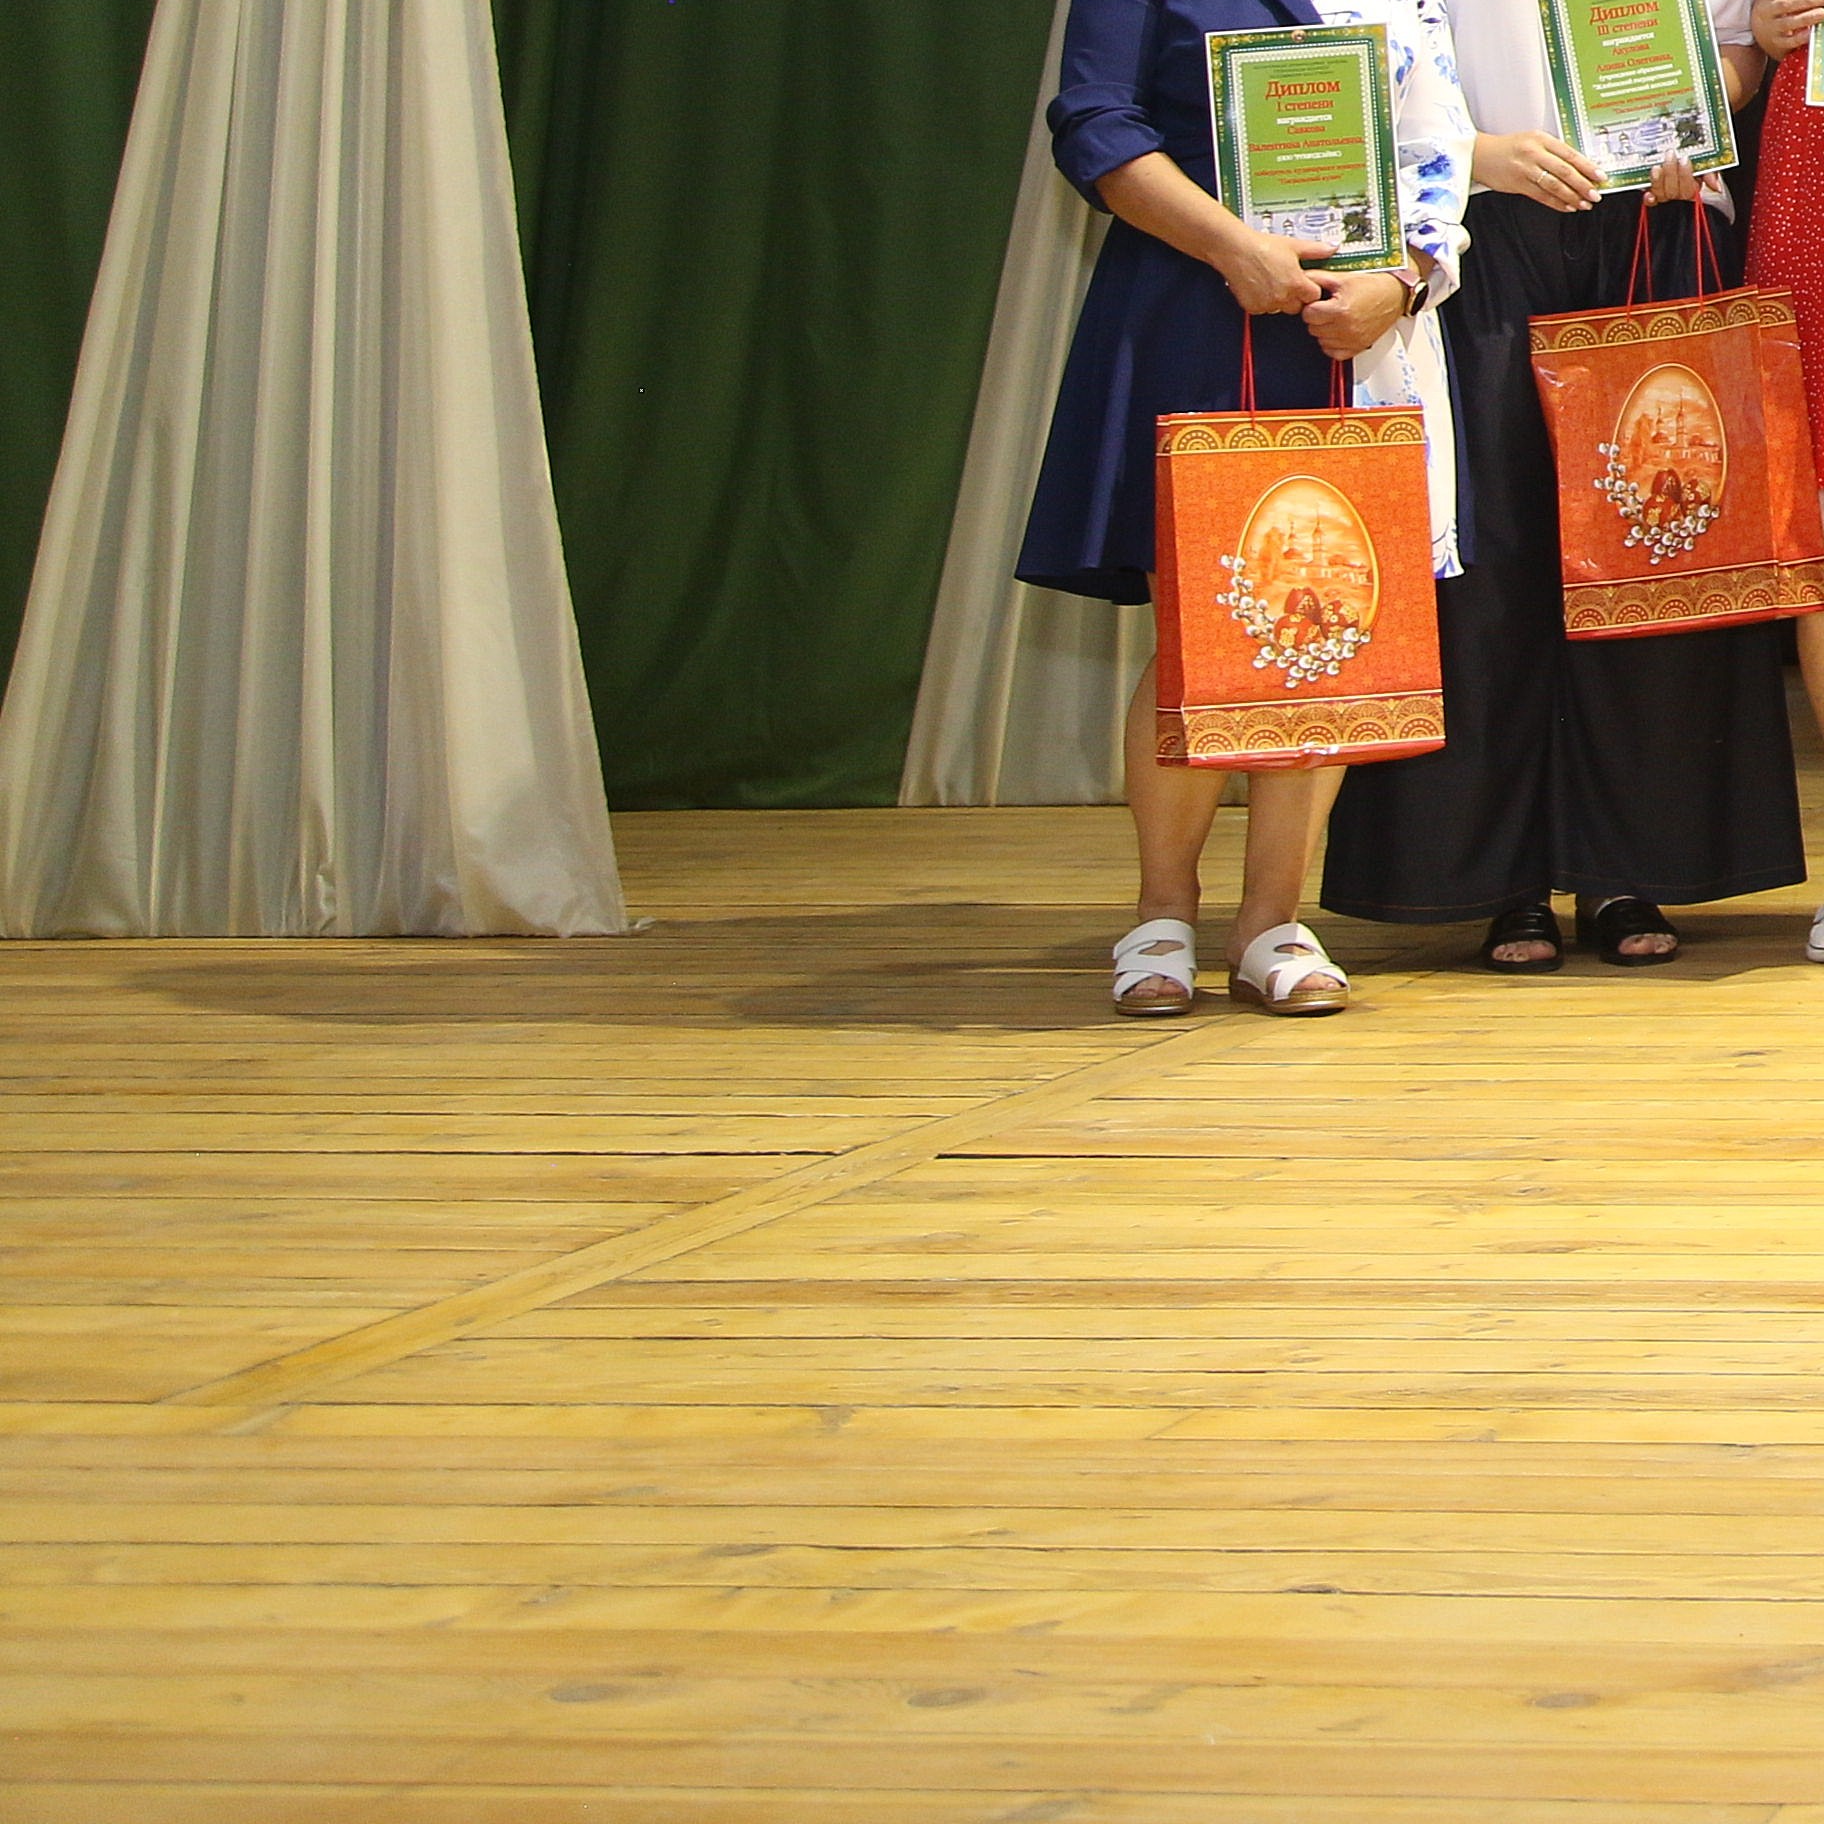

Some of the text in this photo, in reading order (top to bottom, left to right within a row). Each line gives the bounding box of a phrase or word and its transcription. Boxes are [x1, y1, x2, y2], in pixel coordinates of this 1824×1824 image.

[1589, 1, 1660, 26] Диплом
[1612, 18, 1659, 33] степени
[1265, 80, 1341, 100] Диплом
[1284, 99, 1334, 112] степени
